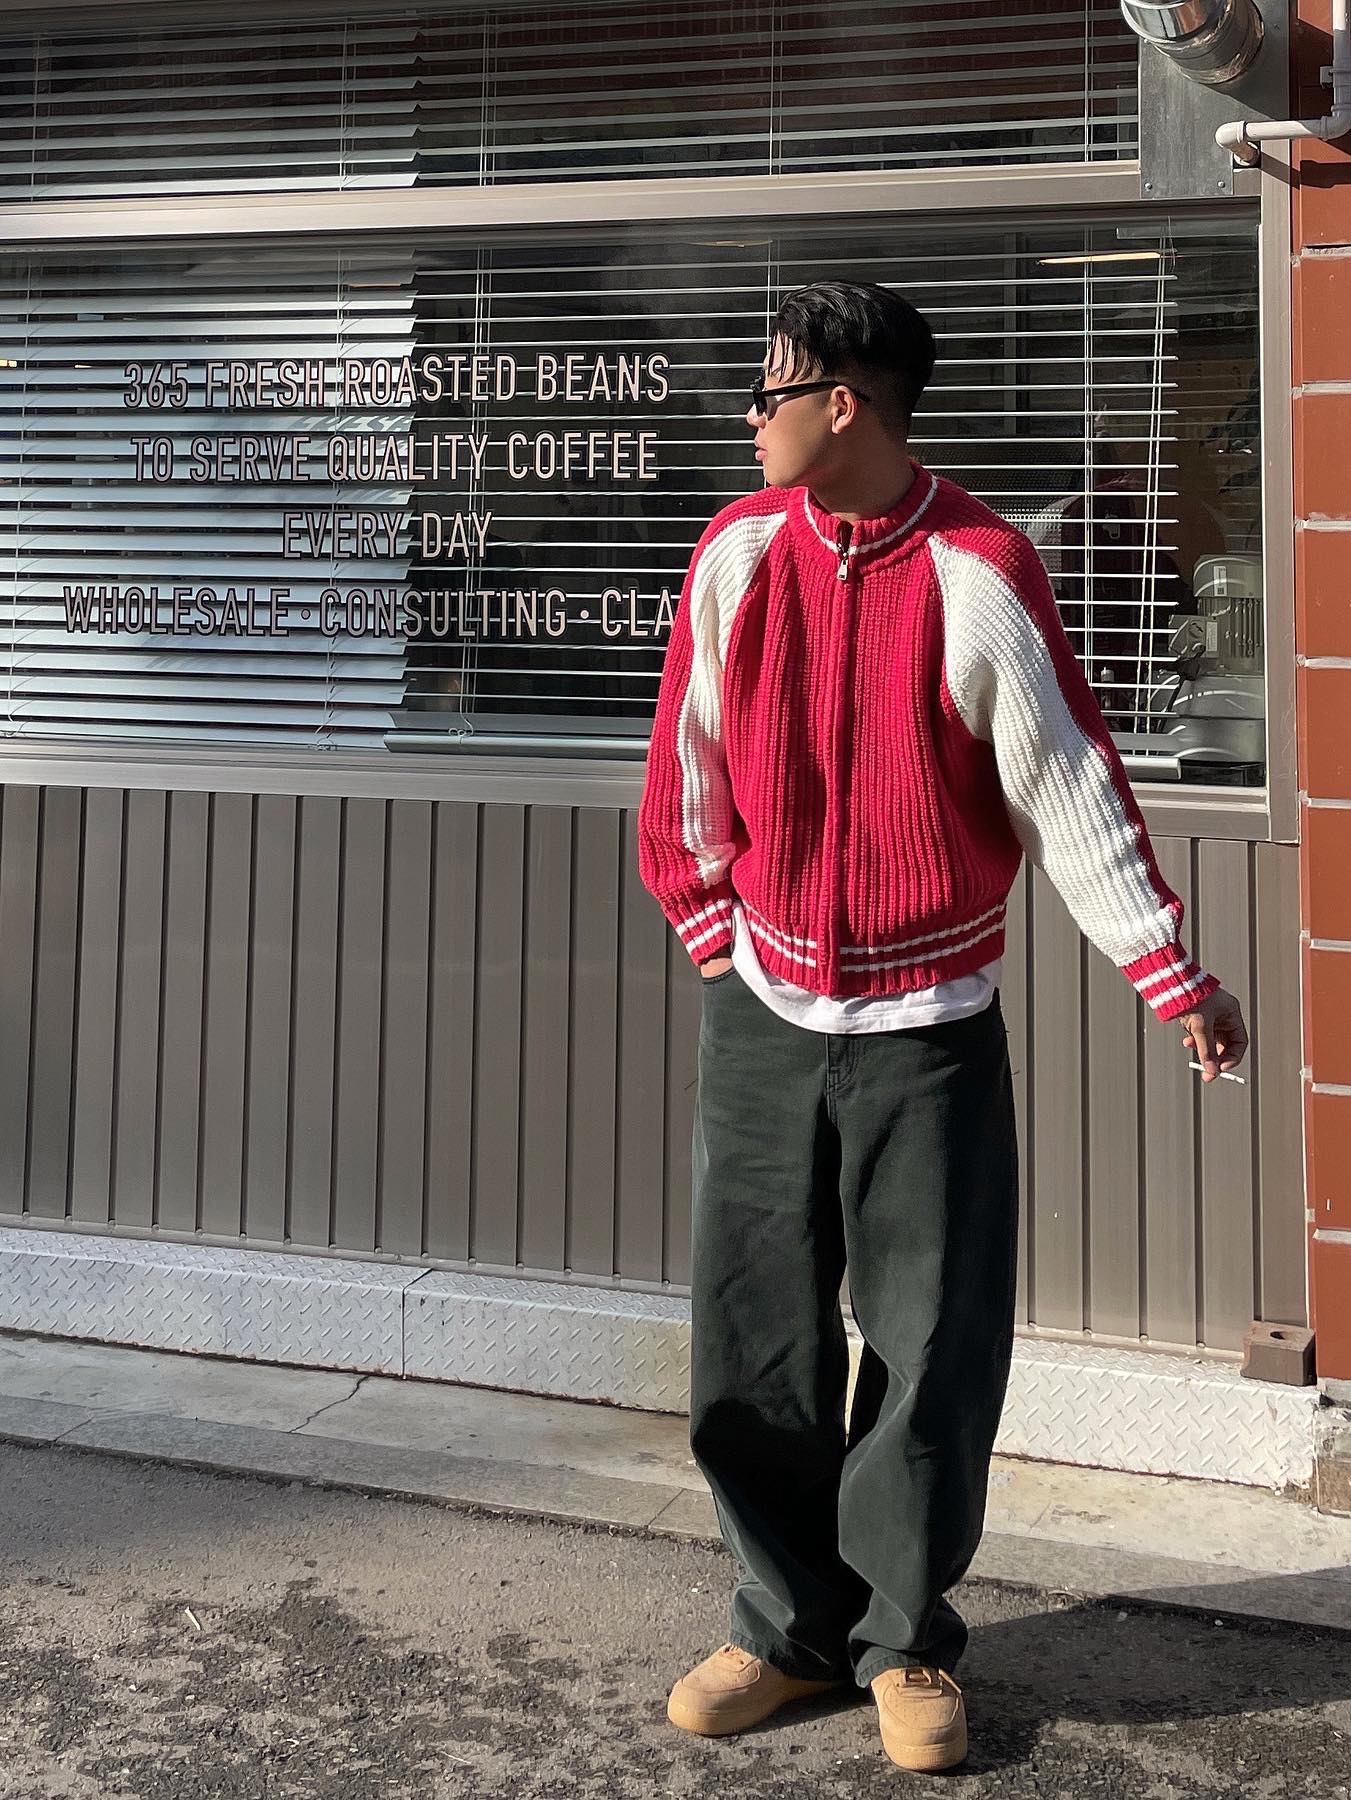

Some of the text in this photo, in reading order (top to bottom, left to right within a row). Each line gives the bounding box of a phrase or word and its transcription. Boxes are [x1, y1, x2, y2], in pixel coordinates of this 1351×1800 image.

[124, 353, 670, 407] 365 FRESH ROASTED BEANS
[131, 431, 658, 482] TO SERVE QUALITY COFFEE
[283, 511, 493, 559] EVERY DAY
[63, 586, 290, 637] WHOLESALE
[320, 588, 568, 638] CONSULTING
